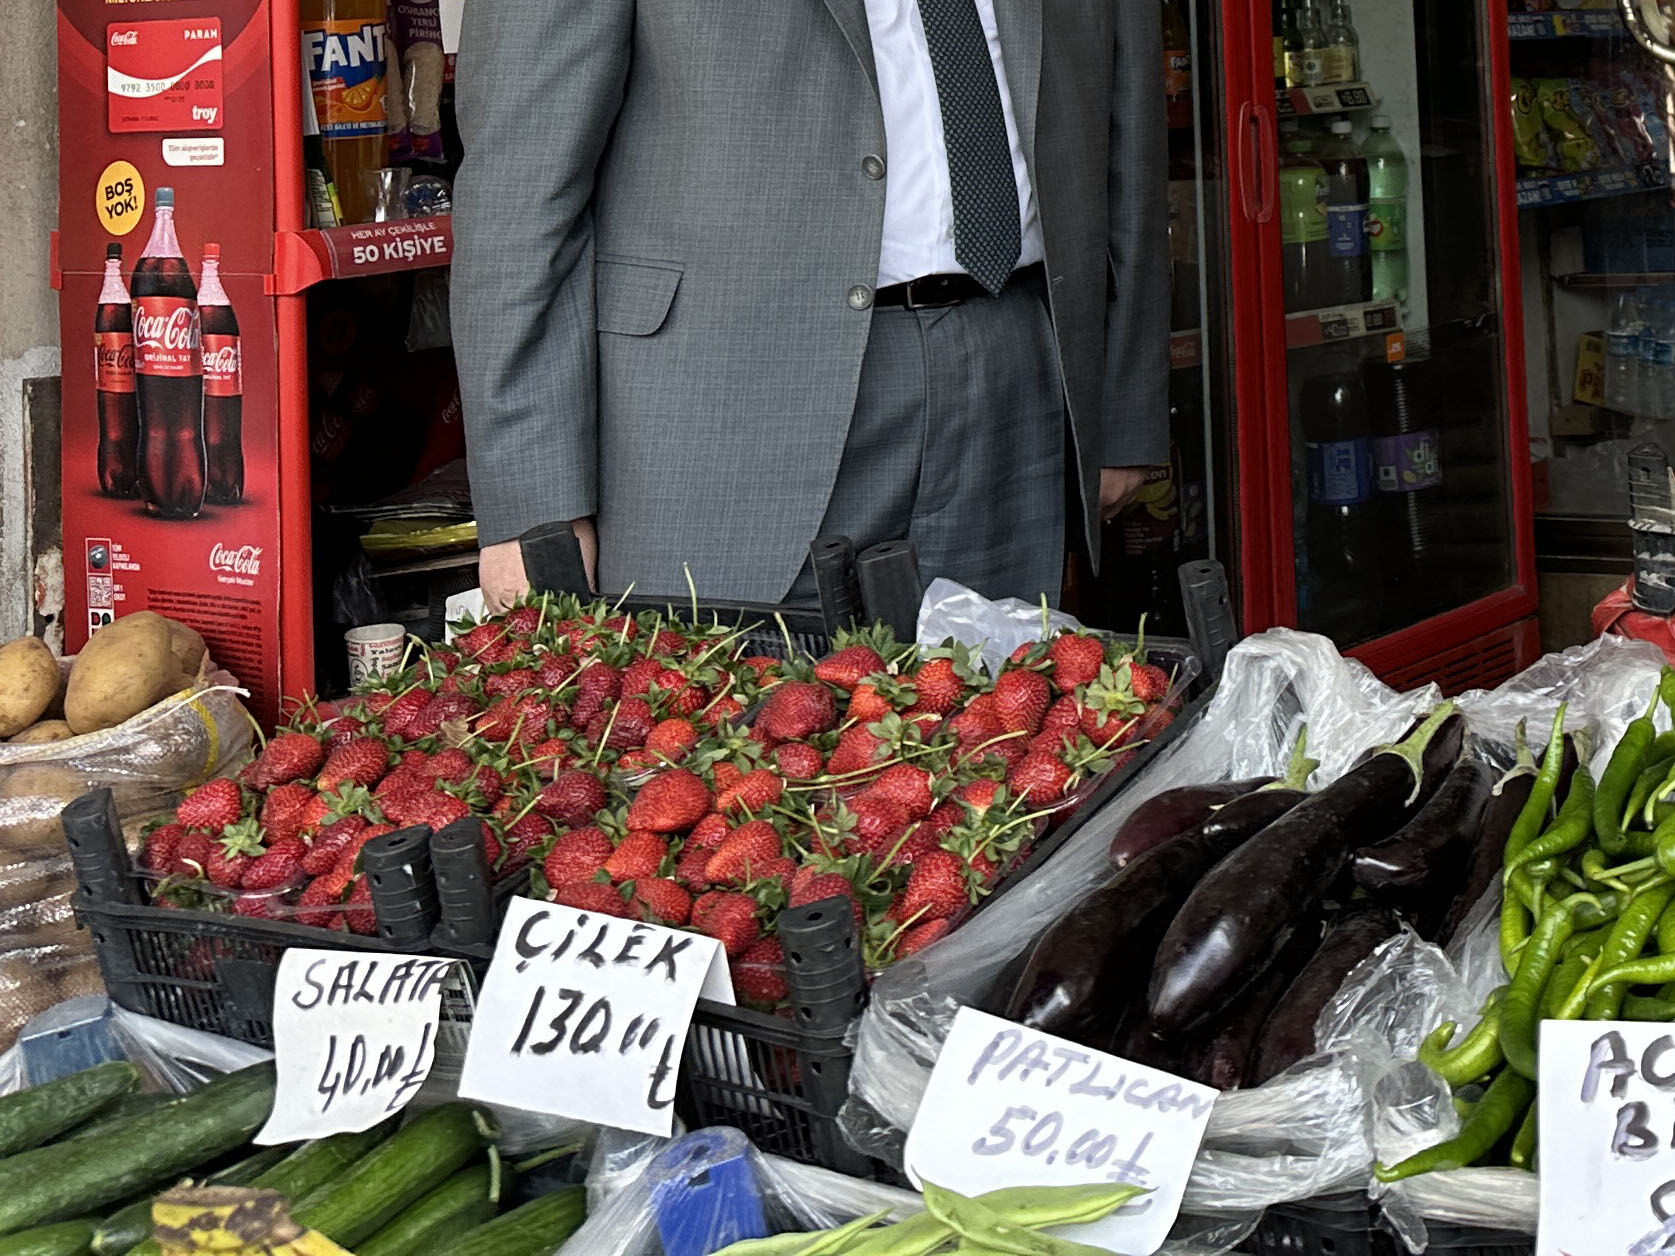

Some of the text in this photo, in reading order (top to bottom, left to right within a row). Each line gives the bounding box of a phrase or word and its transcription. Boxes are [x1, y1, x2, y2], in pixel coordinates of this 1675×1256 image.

[301, 24, 386, 72] FANT
[191, 105, 217, 124] troy
[104, 177, 134, 201] BOŞ
[105, 194, 138, 219] YOK!
[353, 233, 447, 265] 50 KİŞİYE
[133, 305, 201, 351] Coca-Cola
[209, 542, 263, 576] Coca-Cola
[514, 910, 694, 984] ÇİLEK
[291, 958, 451, 1012] SALATA
[966, 1027, 1217, 1120] PATLICAN
